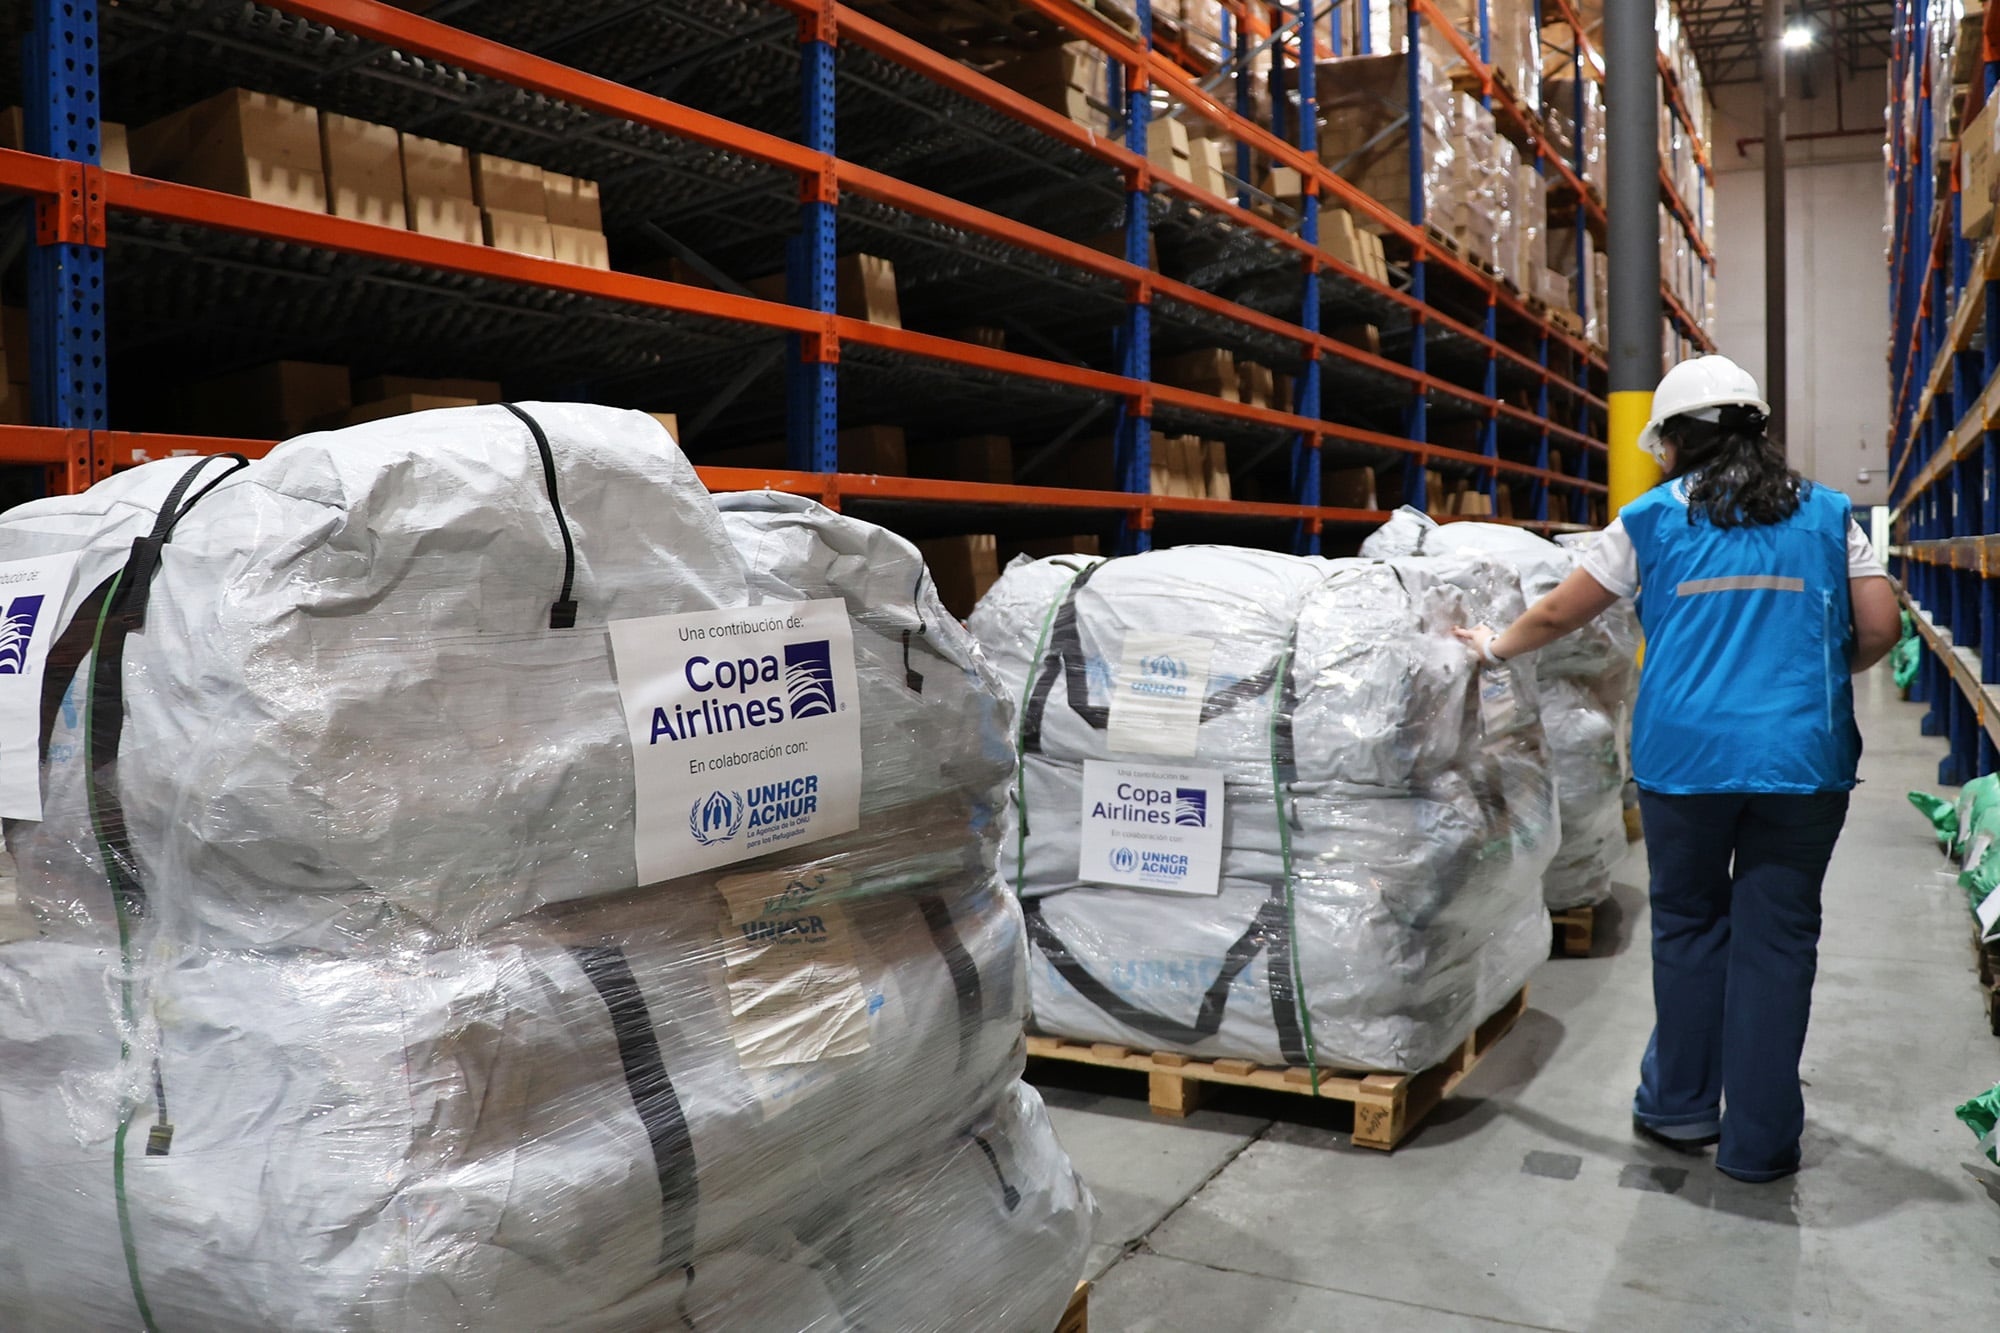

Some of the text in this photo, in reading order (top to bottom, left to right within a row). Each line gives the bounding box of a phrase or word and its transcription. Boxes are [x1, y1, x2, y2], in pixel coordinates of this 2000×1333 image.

[679, 616, 805, 642] Una contribución de:
[685, 655, 779, 693] Copa
[1131, 681, 1188, 696] UNHCR
[650, 696, 784, 745] Airlines
[689, 740, 808, 774] En colaboración con:
[747, 775, 818, 807] UNHCR
[1117, 783, 1171, 805] Copa
[748, 795, 818, 829] ACNUR
[1091, 801, 1171, 824] Airlines
[756, 824, 780, 836] Agencia
[772, 828, 806, 842] Refugiados
[1141, 851, 1188, 866] UNHCR
[1141, 861, 1188, 876] ACNUR
